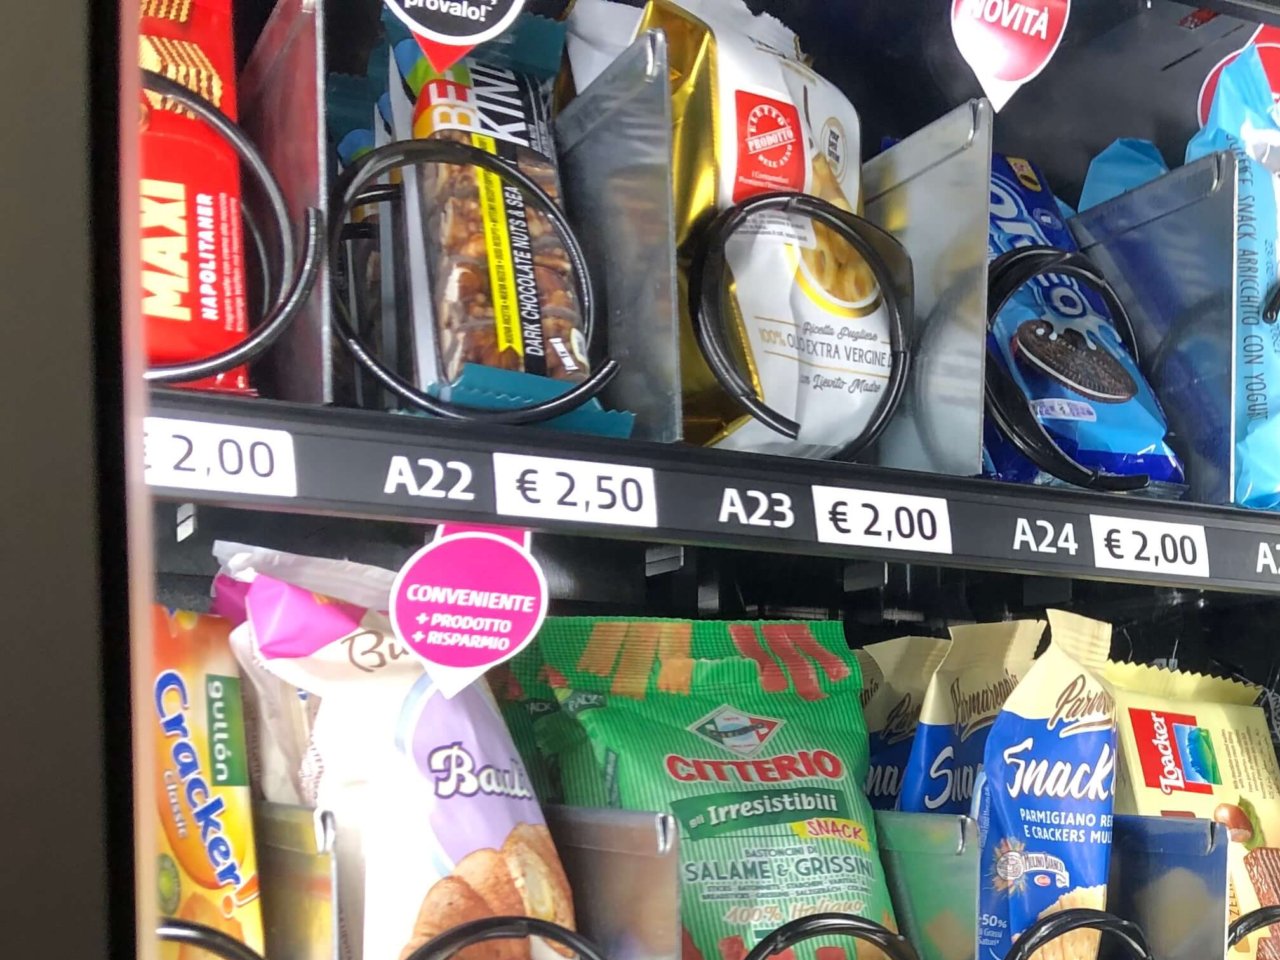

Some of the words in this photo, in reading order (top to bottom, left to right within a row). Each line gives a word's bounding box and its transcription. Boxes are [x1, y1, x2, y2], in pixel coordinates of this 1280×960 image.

[968, 0, 1049, 39] NOVITÀ
[747, 127, 795, 153] PRODOTTO
[504, 186, 525, 207] SEA
[508, 215, 532, 248] NUTS
[1236, 191, 1256, 248] SNACK
[140, 178, 191, 321] MAXI
[196, 193, 219, 321] NAPOLITANER
[513, 249, 540, 320] CHOCOLATE
[1236, 247, 1260, 327] ARRICCHITO
[526, 321, 544, 357] DARK
[806, 336, 841, 359] EXTRA
[844, 342, 889, 367] VERGINE
[1242, 333, 1265, 361] CON
[171, 434, 275, 477] 2,00
[384, 454, 476, 501] A22
[516, 468, 539, 504] €
[556, 471, 645, 512] 2,50
[718, 487, 796, 529] A23
[828, 500, 852, 533] €
[863, 501, 938, 543] 2,00
[1012, 517, 1080, 556] A24
[1104, 529, 1124, 559] €
[1133, 529, 1198, 567] 2,00
[406, 583, 536, 613] CONVENIENTE
[430, 613, 512, 633] PRODOTTO
[426, 630, 510, 651] RISPARMIO
[666, 749, 844, 783] CITTERIO
[1151, 711, 1184, 796] Loacker
[153, 669, 242, 889] Cracker
[707, 793, 838, 826] Irresistibili
[1020, 807, 1096, 828] PARMIGIANO
[807, 818, 865, 842] SNACK
[1032, 827, 1085, 843] CRACKERS
[745, 846, 804, 859] BASTONCINI
[684, 860, 771, 882] SALAME
[776, 862, 789, 877] &
[724, 904, 783, 924] 100%
